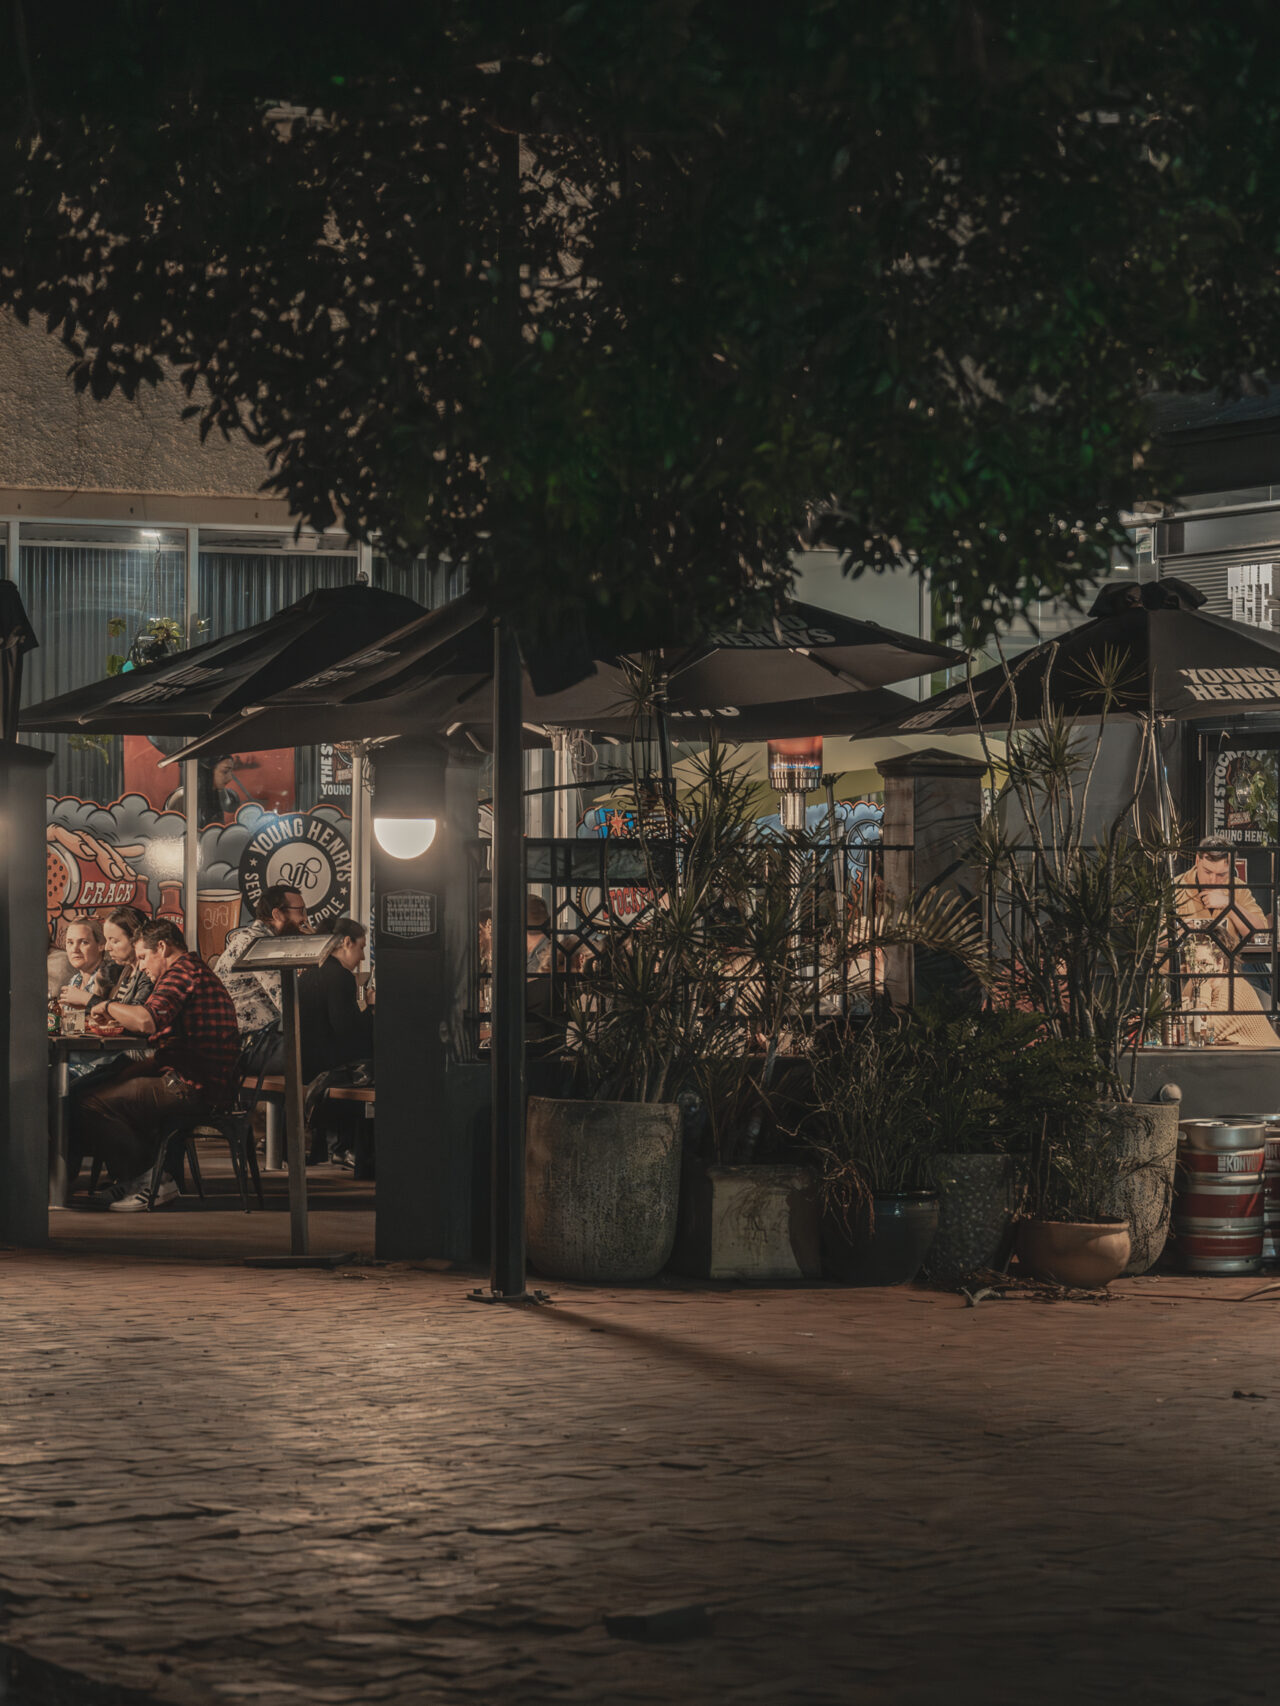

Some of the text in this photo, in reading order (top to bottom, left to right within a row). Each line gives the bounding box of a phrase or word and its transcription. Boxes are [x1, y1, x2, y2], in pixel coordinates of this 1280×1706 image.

[1227, 563, 1280, 632] THE
[320, 756, 333, 783] THE
[1214, 798, 1225, 829] THE
[249, 817, 351, 882] YOUNG HENRYS
[79, 880, 134, 905] CRACK
